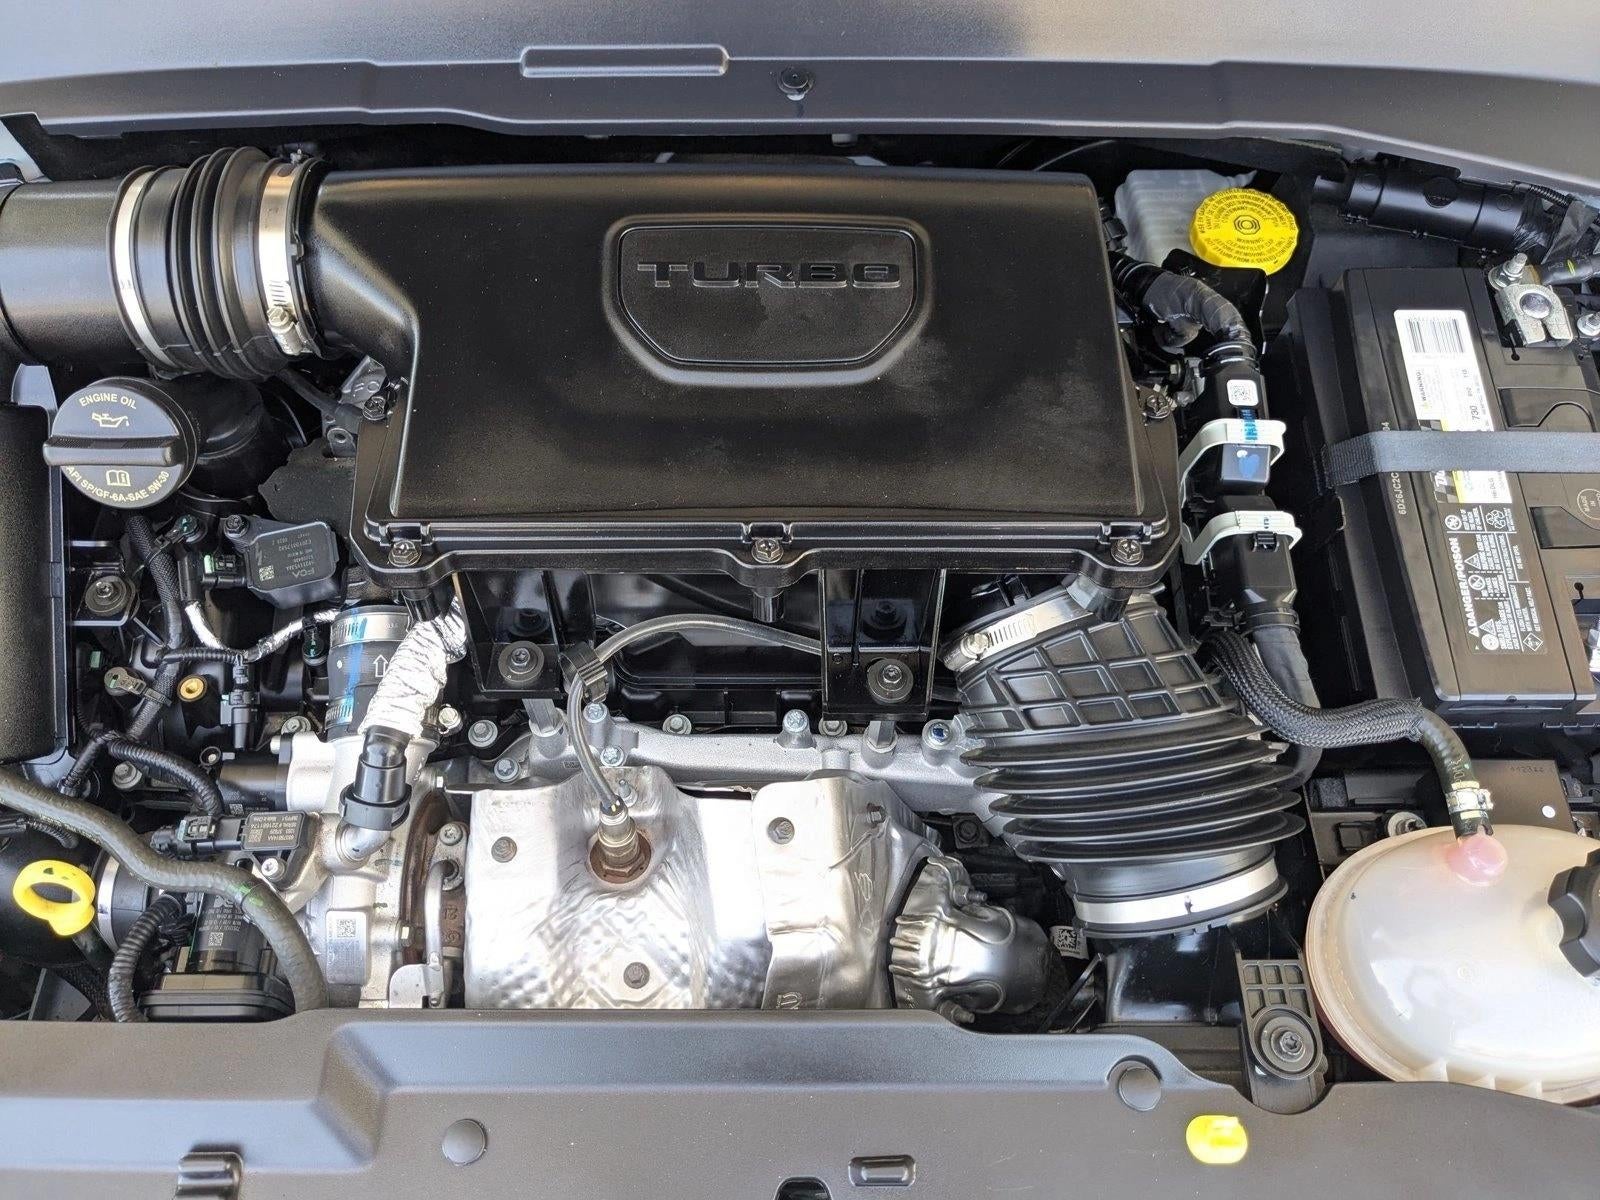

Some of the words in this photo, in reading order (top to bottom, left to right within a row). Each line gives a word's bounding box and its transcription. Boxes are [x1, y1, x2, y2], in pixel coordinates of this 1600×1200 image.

[637, 262, 901, 289] TURBO
[79, 393, 118, 407] ENGINE
[120, 396, 137, 410] OIL
[66, 466, 82, 482] API
[148, 470, 170, 494] 5W-30
[292, 568, 315, 578] FCA
[1448, 536, 1477, 627] DANGER/POISON
